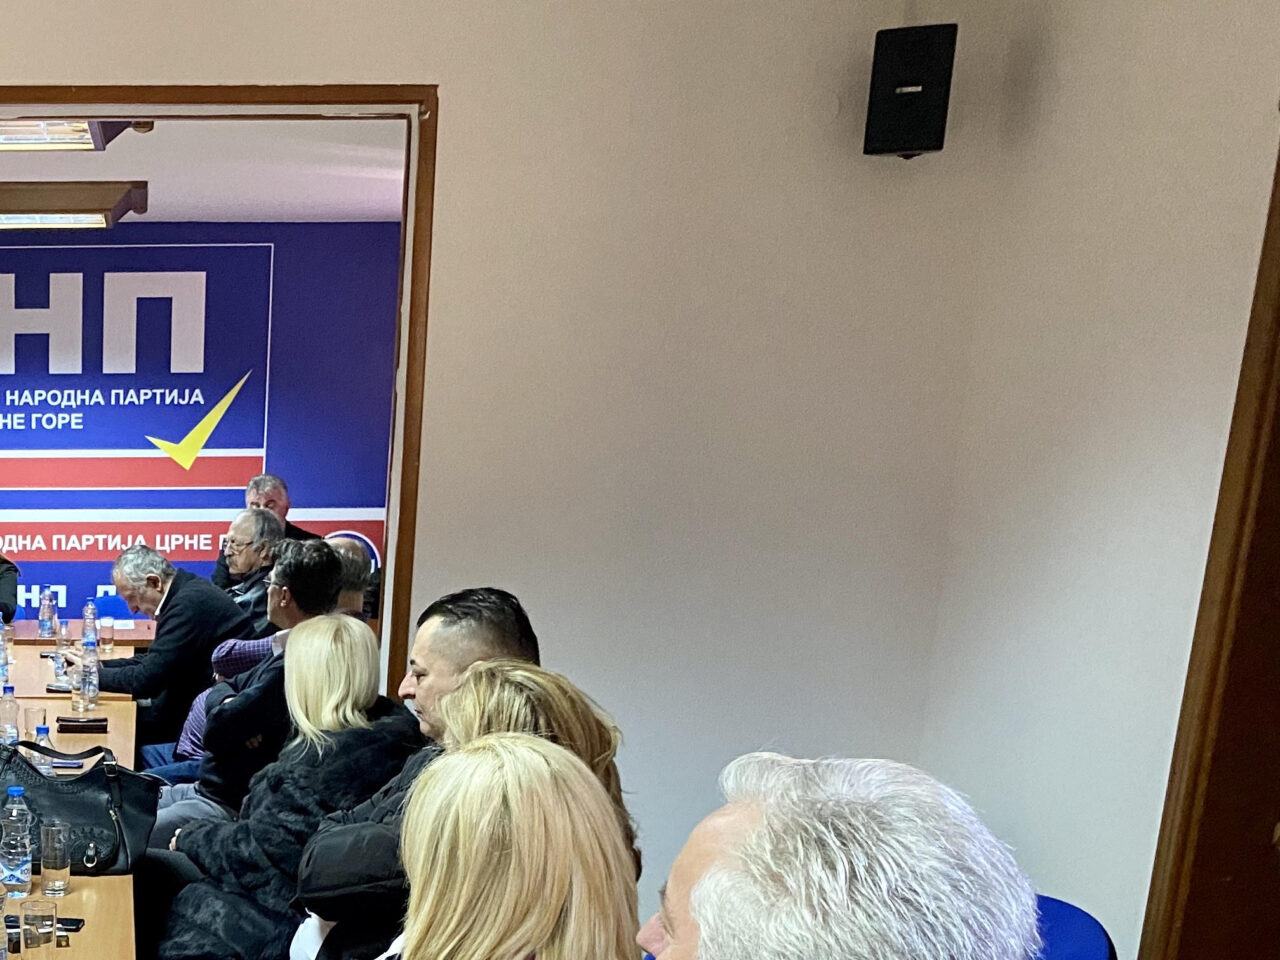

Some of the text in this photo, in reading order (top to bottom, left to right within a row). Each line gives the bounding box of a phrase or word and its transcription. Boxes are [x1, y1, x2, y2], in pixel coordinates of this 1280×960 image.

[5, 389, 105, 408] НАРОДНА
[111, 388, 205, 406] ПАРТИЈА
[31, 413, 84, 430] ГОРЕ
[155, 534, 213, 552] ЦРНЕ
